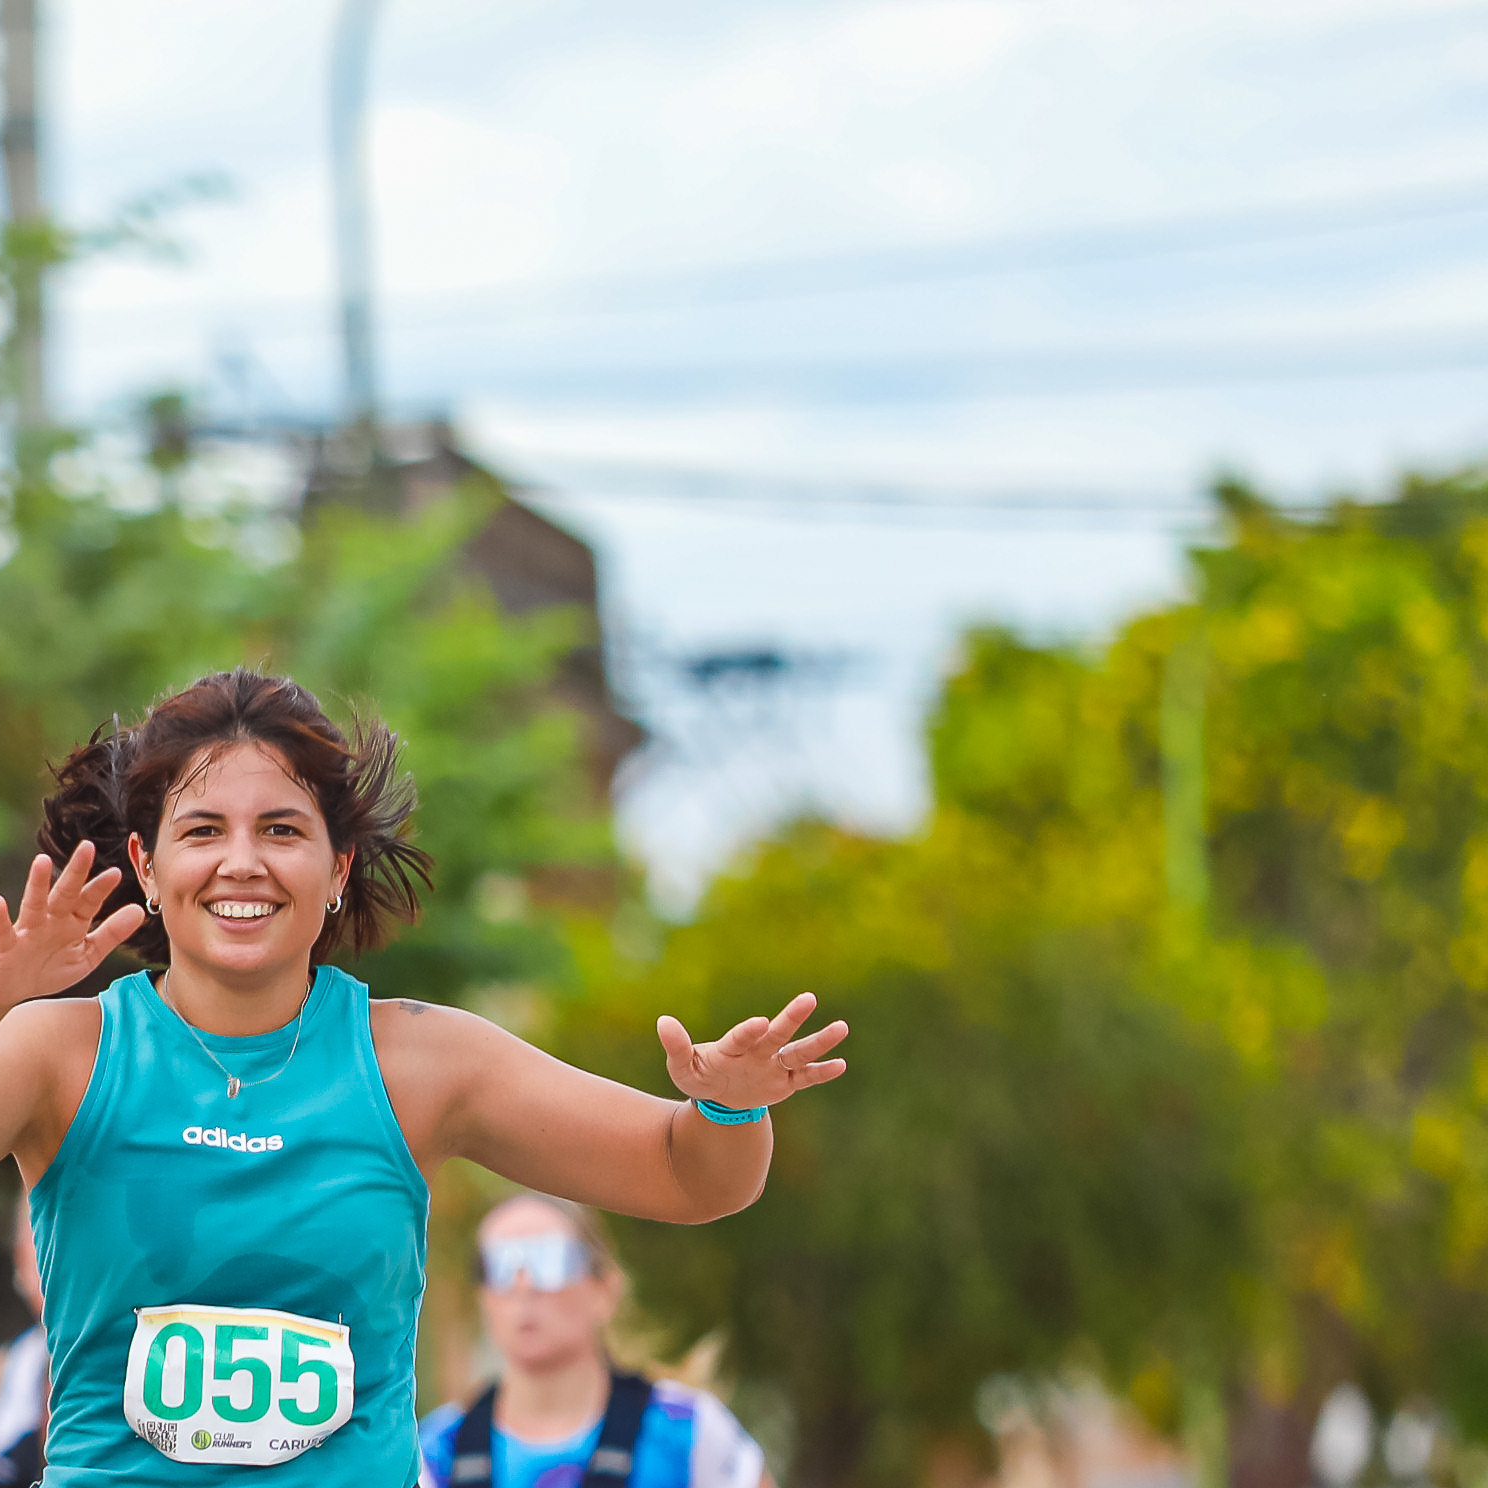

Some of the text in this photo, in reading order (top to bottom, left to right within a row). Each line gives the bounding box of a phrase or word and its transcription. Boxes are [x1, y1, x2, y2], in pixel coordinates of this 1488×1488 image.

[182, 1126, 284, 1153] adidas
[142, 1322, 338, 1426] 055
[213, 1432, 235, 1441] CLUB
